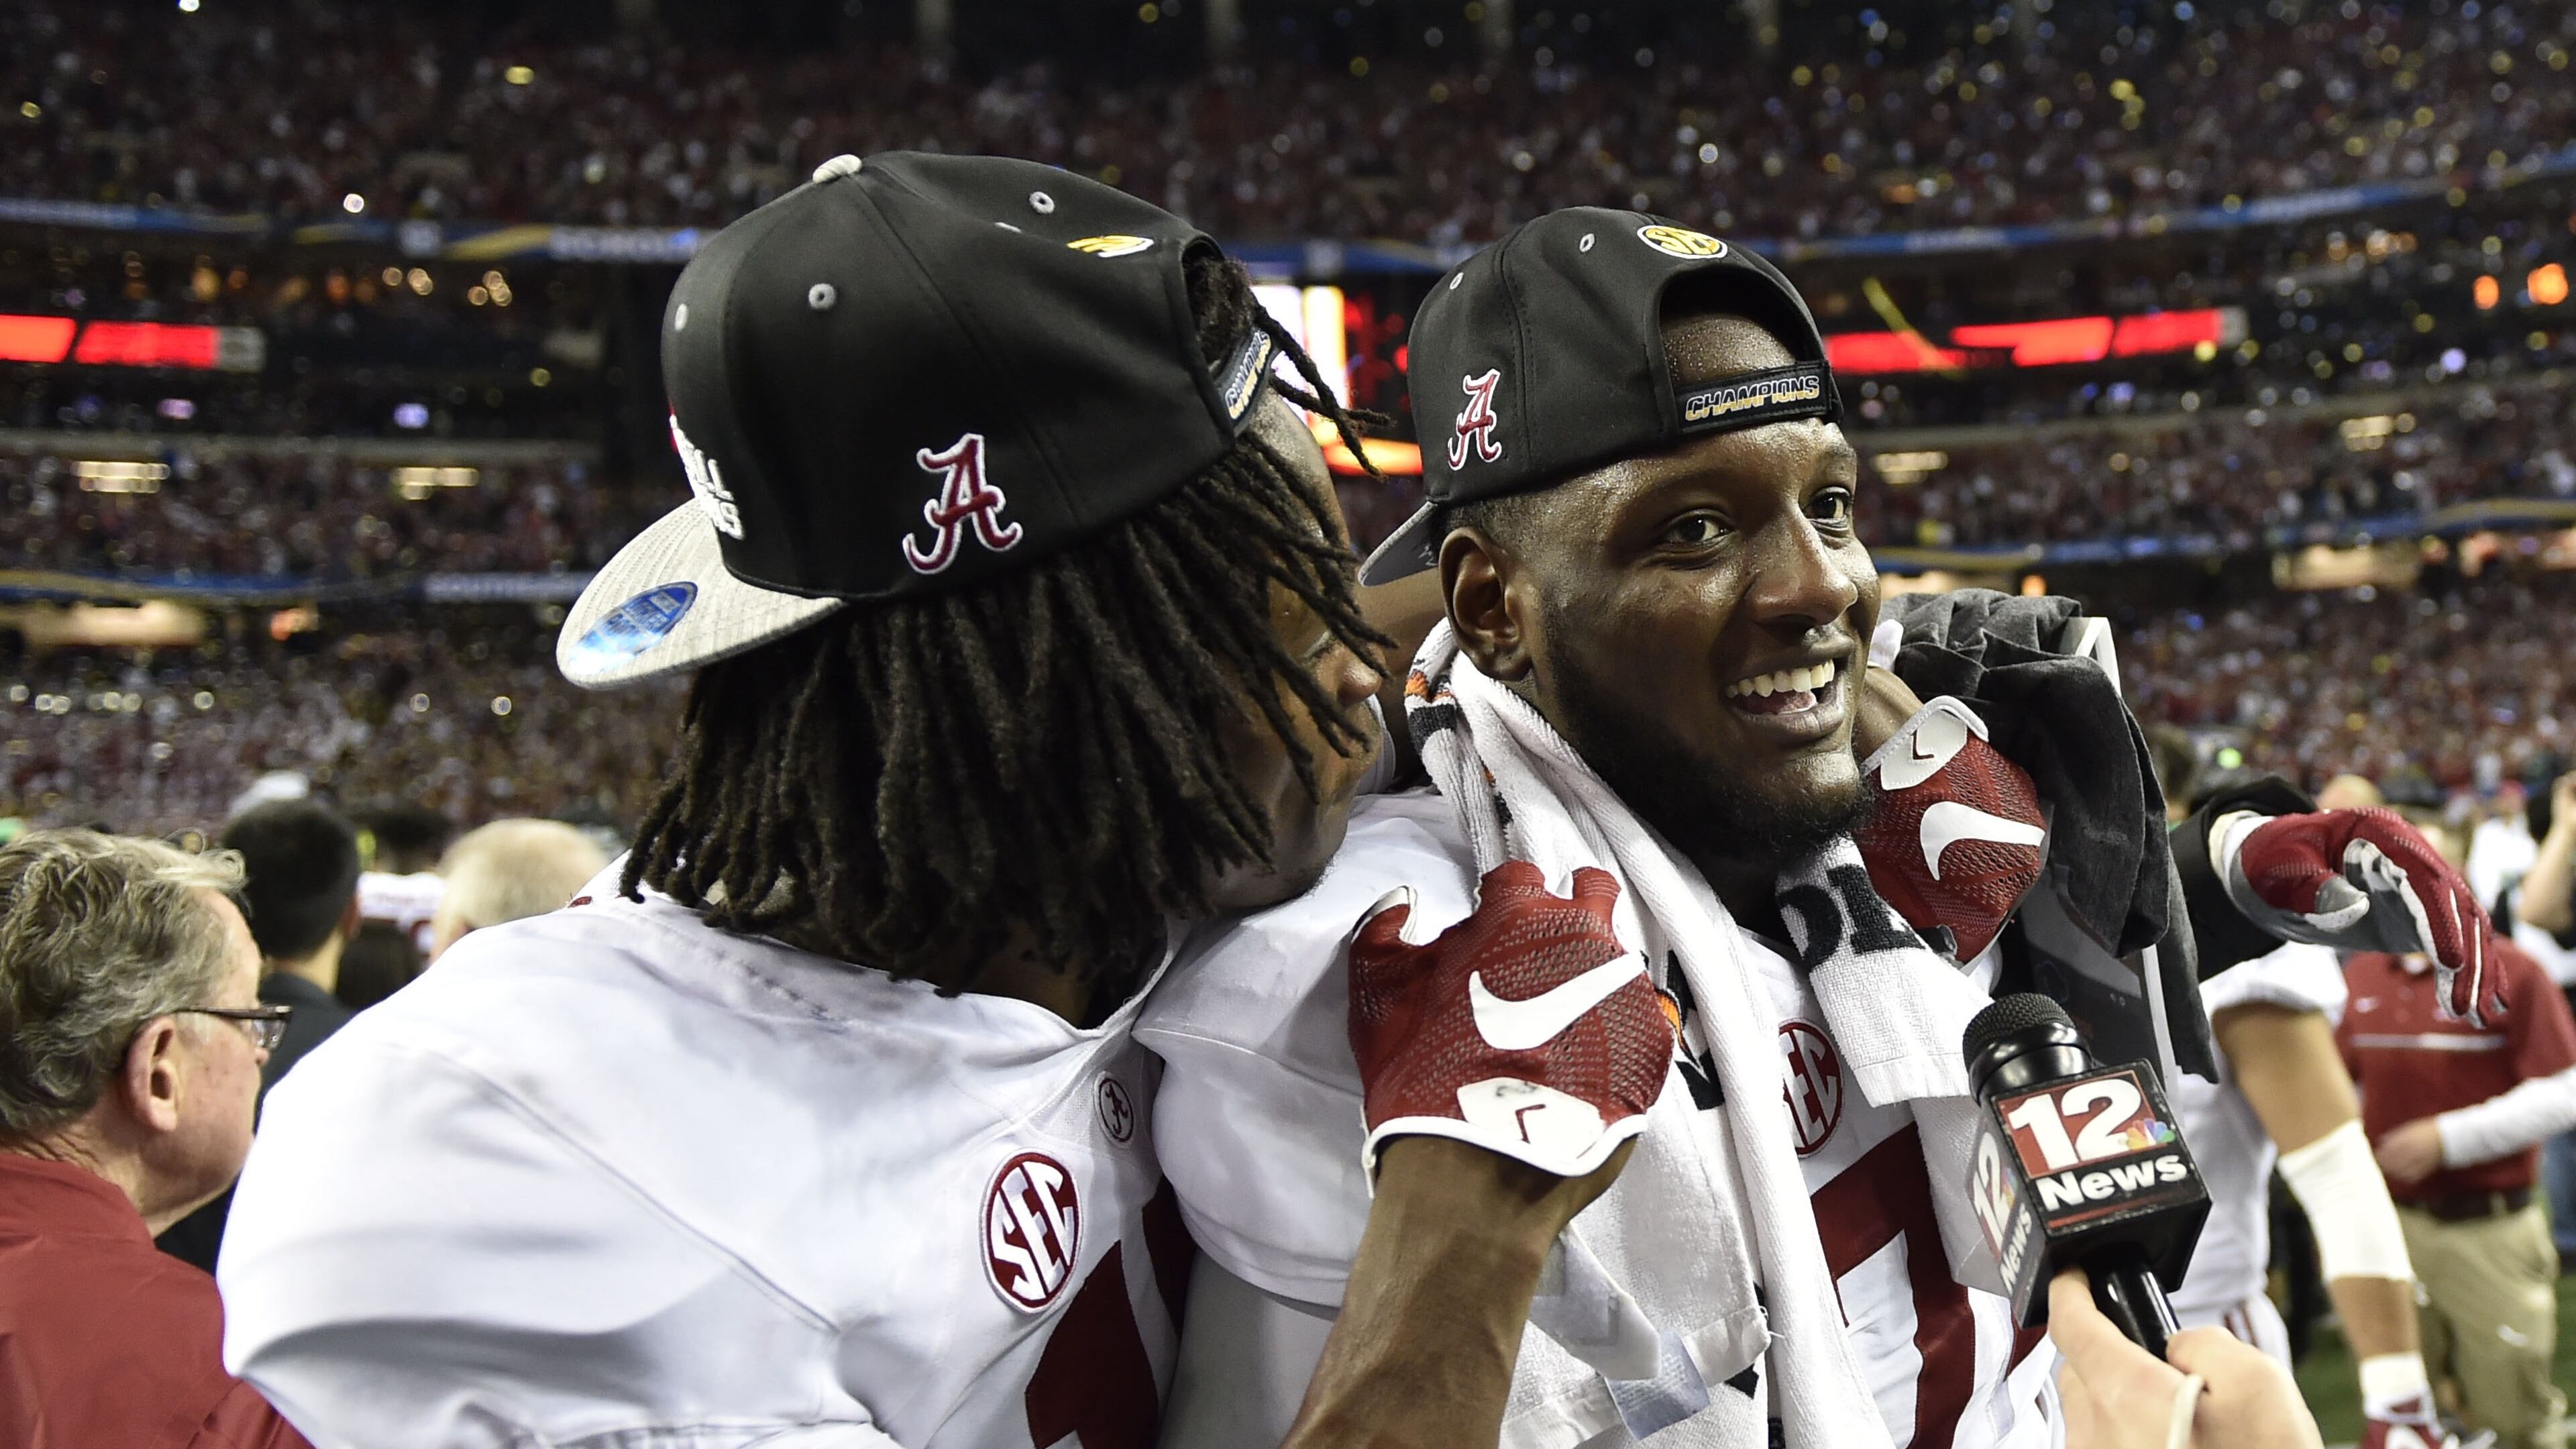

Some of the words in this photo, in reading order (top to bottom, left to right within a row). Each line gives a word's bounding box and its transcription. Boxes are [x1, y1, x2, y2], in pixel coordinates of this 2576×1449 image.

[1447, 368, 1502, 471] A
[1684, 375, 1820, 421] CHAMPIONS
[902, 433, 1024, 575] A
[1778, 1028, 1842, 1148] EC
[2008, 1078, 2142, 1171] 12
[989, 1160, 1075, 1301] SEC
[1972, 1132, 2011, 1246] 12
[2035, 1154, 2188, 1212] News
